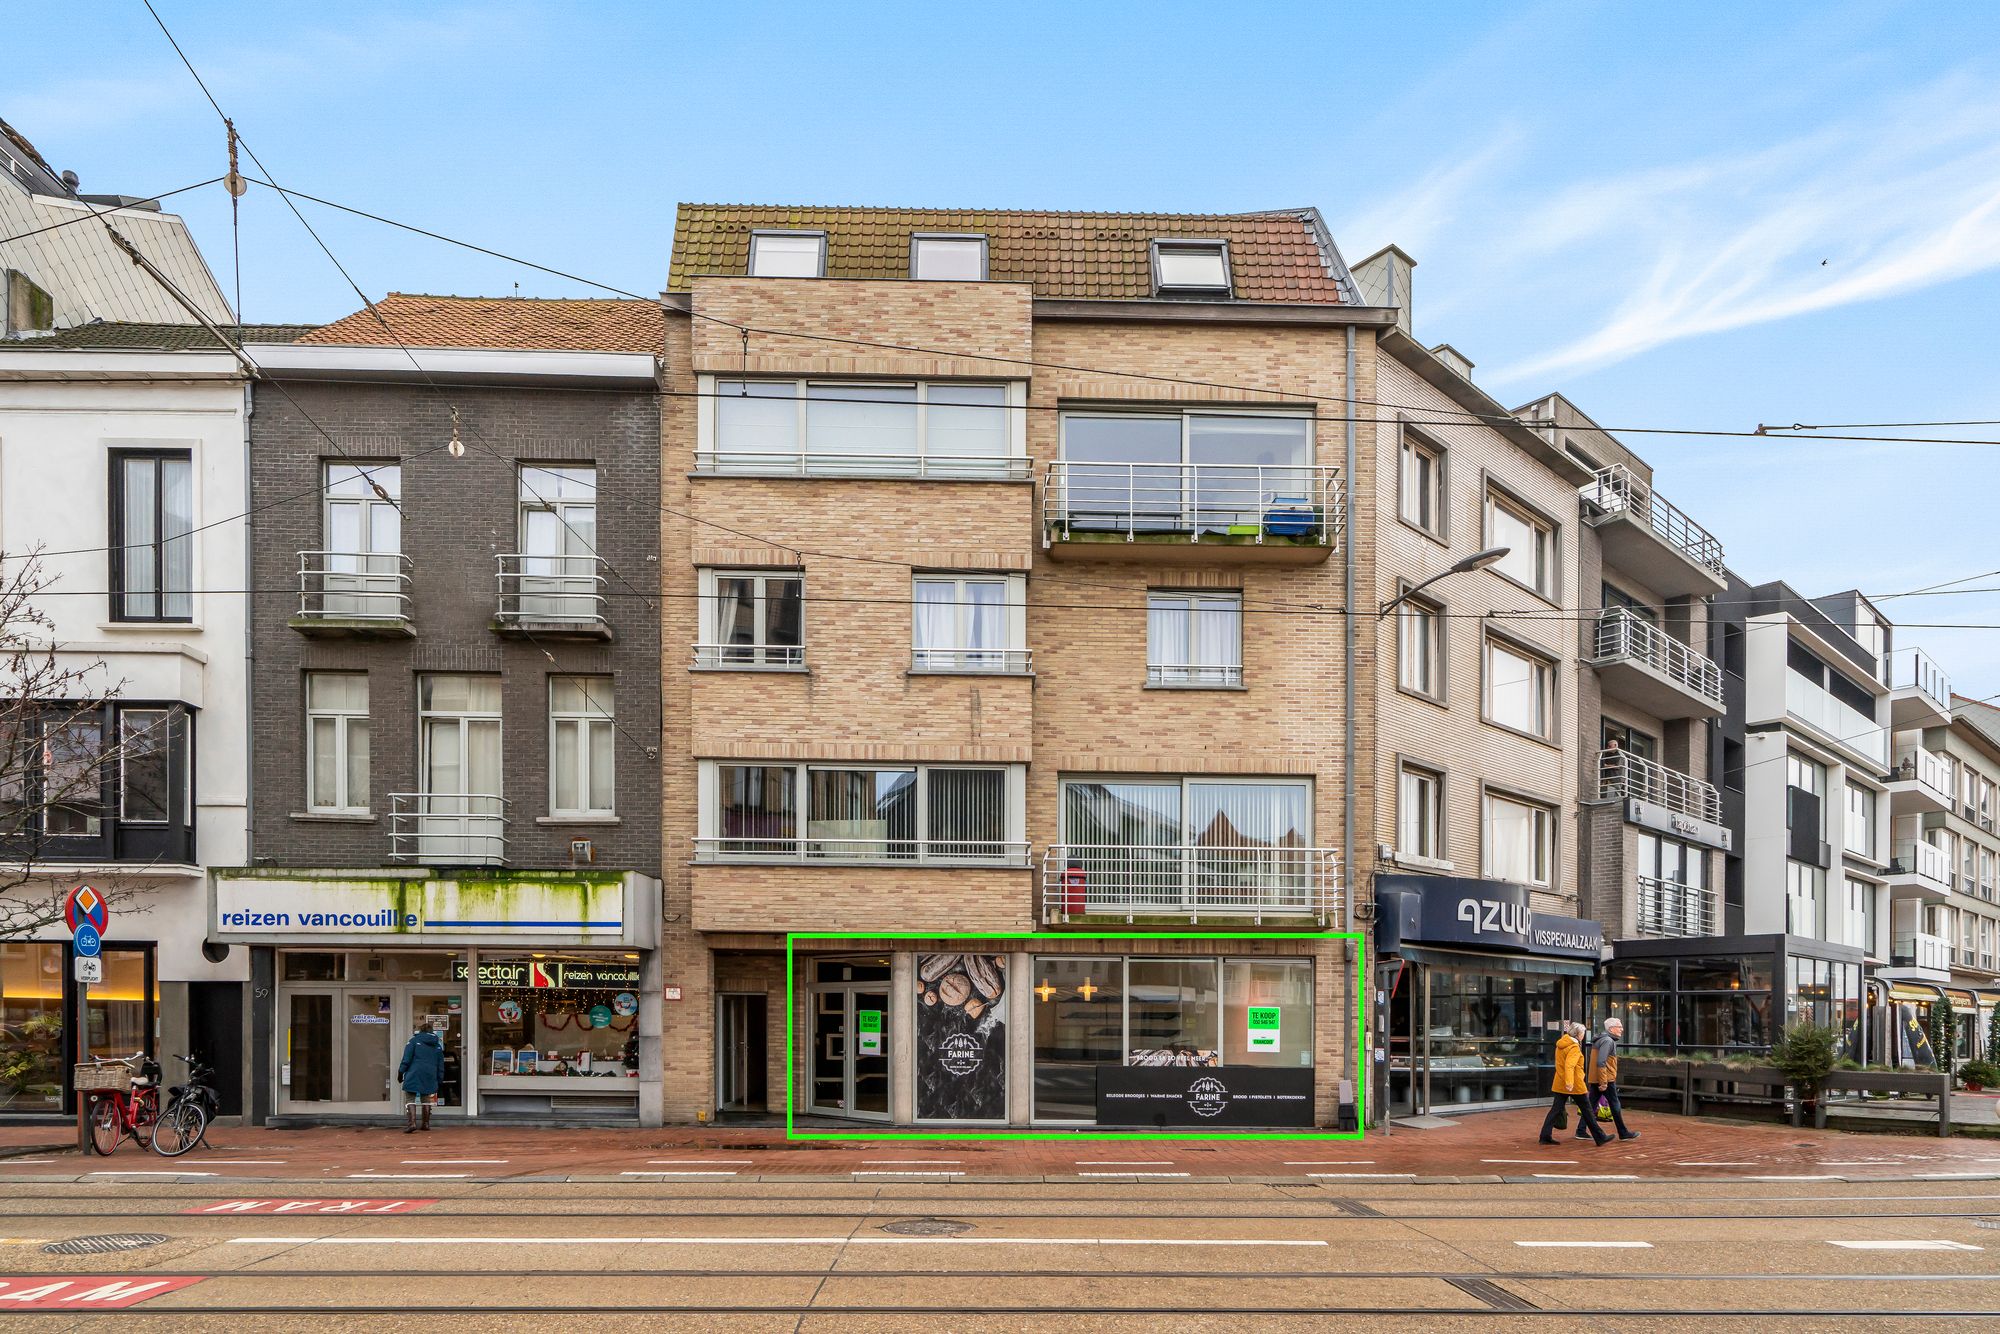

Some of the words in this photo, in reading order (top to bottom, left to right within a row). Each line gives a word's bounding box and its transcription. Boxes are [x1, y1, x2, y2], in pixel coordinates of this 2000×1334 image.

[222, 909, 290, 926] reizen
[1534, 929, 1598, 951] VISSPECIAALZAAK
[456, 965, 525, 980] seectair
[563, 970, 593, 980] reizen
[255, 987, 269, 998] 59
[947, 1050, 975, 1058] FARINE
[1195, 1093, 1221, 1101] FARINE
[203, 1201, 406, 1213] TRAM
[0, 1281, 172, 1302] AM
